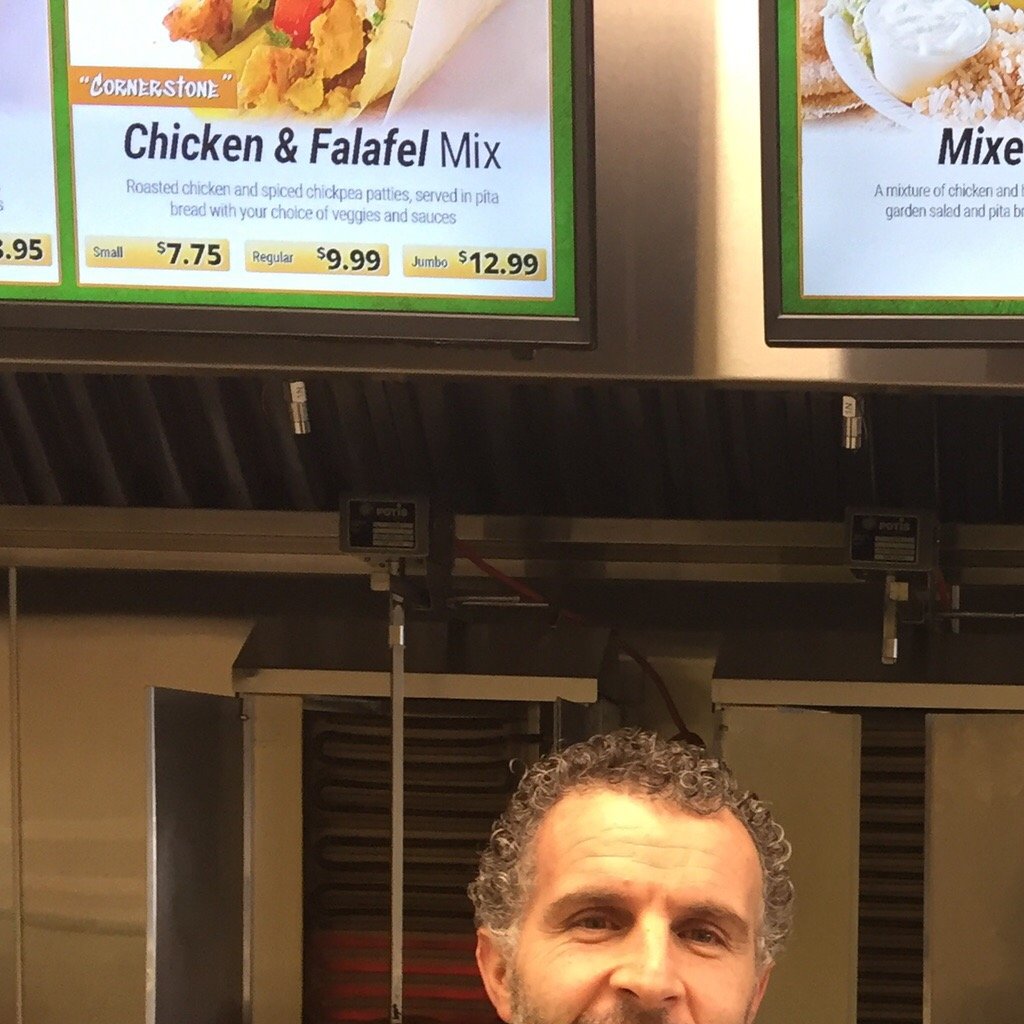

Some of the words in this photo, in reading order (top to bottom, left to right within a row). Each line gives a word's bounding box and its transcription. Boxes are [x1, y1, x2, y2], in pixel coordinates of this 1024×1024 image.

[124, 121, 264, 162] Chicken
[274, 126, 299, 163] &
[309, 127, 430, 167] Falafel
[440, 131, 502, 169] Mix
[126, 178, 180, 196] Roasted
[181, 181, 231, 197] chicken
[233, 182, 259, 199] and
[261, 184, 304, 201] spiced
[305, 184, 363, 203] chickpea
[366, 187, 414, 205] patties,
[415, 188, 458, 203] served
[460, 190, 473, 205] in
[475, 190, 501, 207] pita
[874, 184, 884, 197] A
[886, 183, 931, 198] mixture
[933, 183, 946, 198] of
[948, 183, 994, 198] chicken
[995, 184, 1019, 198] and
[170, 201, 207, 217] bread
[209, 203, 237, 218] with
[239, 208, 268, 221] your
[270, 205, 314, 220] choice
[315, 206, 329, 221] of
[331, 208, 382, 226] veggies
[383, 209, 409, 224] and
[411, 211, 457, 225] sauces
[885, 204, 927, 221] garden
[928, 204, 962, 218] salad
[963, 204, 986, 218] and
[989, 204, 1011, 221] pita
[0, 238, 43, 261] .95
[92, 246, 124, 259] Small
[156, 241, 222, 266] $7.75
[252, 251, 295, 266] Regular
[316, 247, 381, 272] $9.99
[411, 256, 449, 269] Jumbo
[458, 252, 539, 276] $12.99
